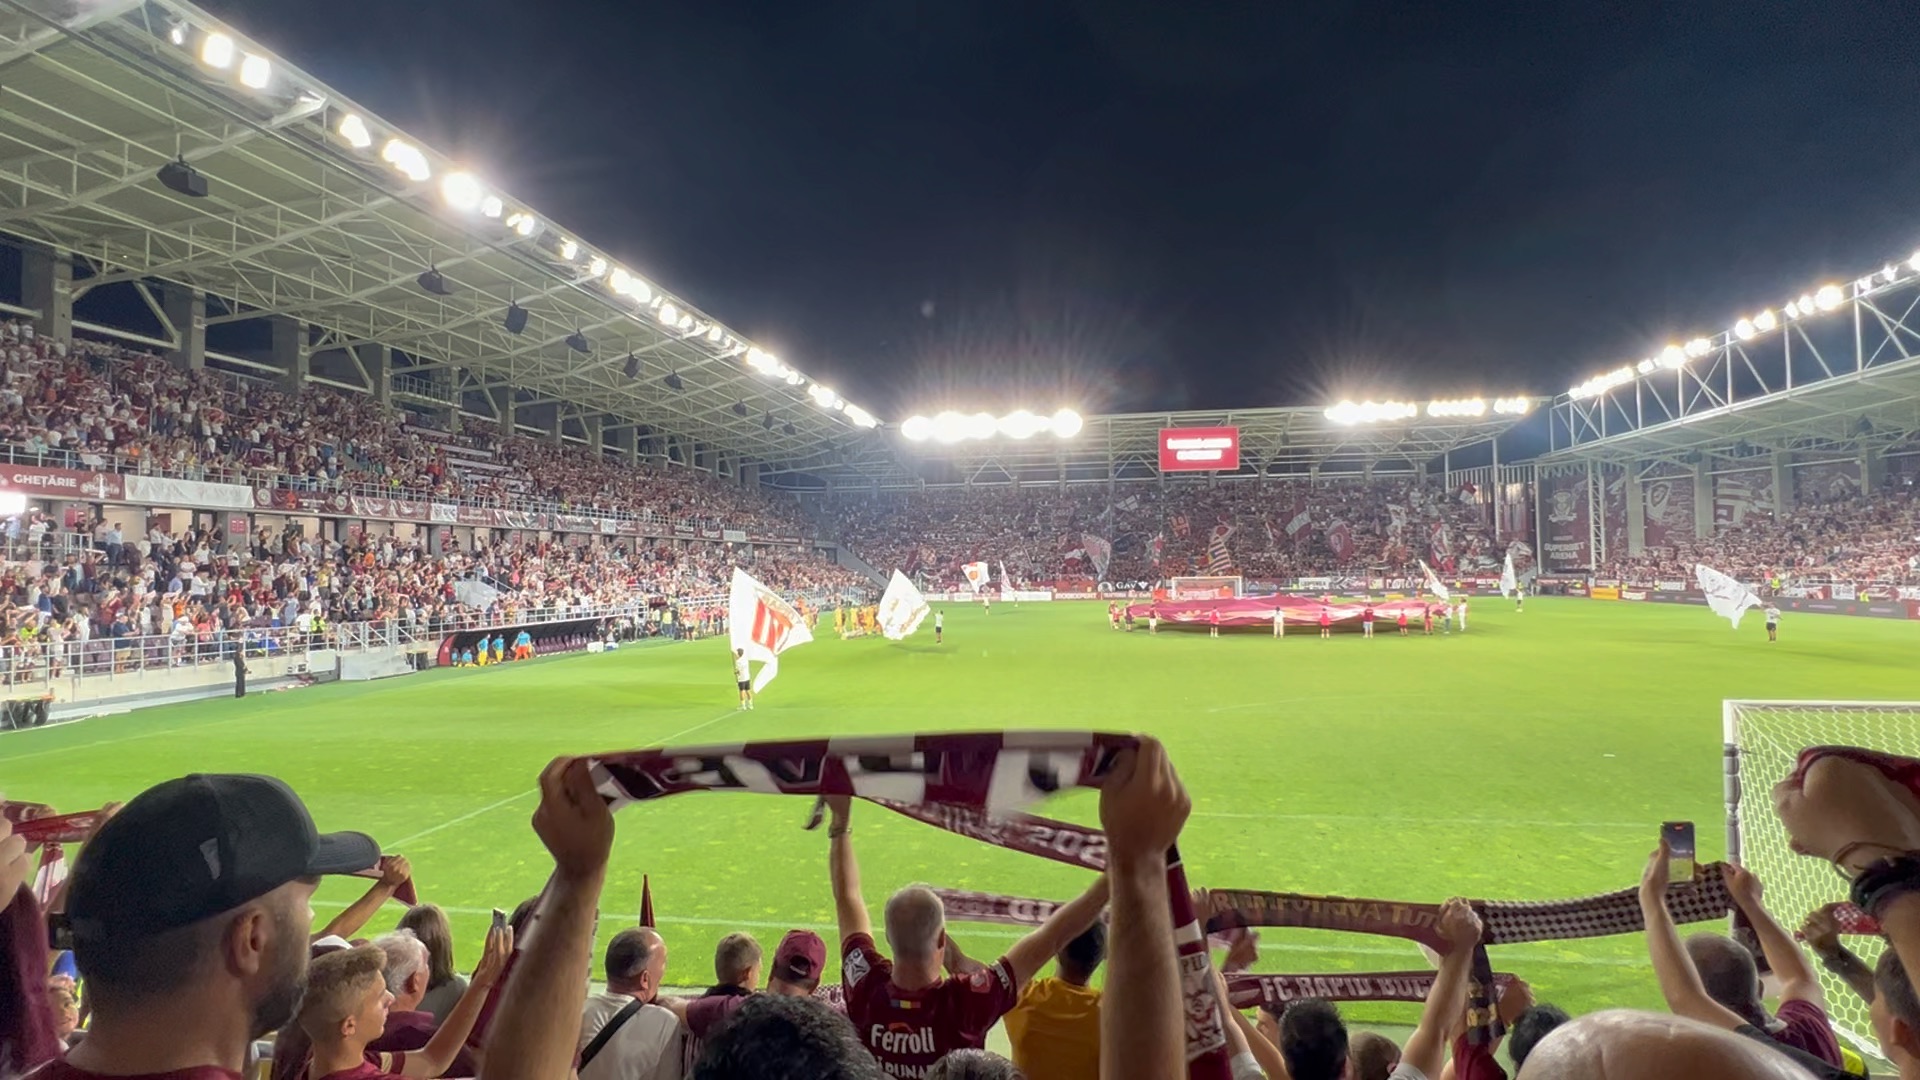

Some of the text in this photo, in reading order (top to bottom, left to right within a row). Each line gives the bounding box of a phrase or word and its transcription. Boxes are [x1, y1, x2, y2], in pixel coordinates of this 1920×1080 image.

[1260, 976, 1293, 1002] FC
[1295, 976, 1373, 999] RAPID
[871, 1023, 936, 1054] Ferroli
